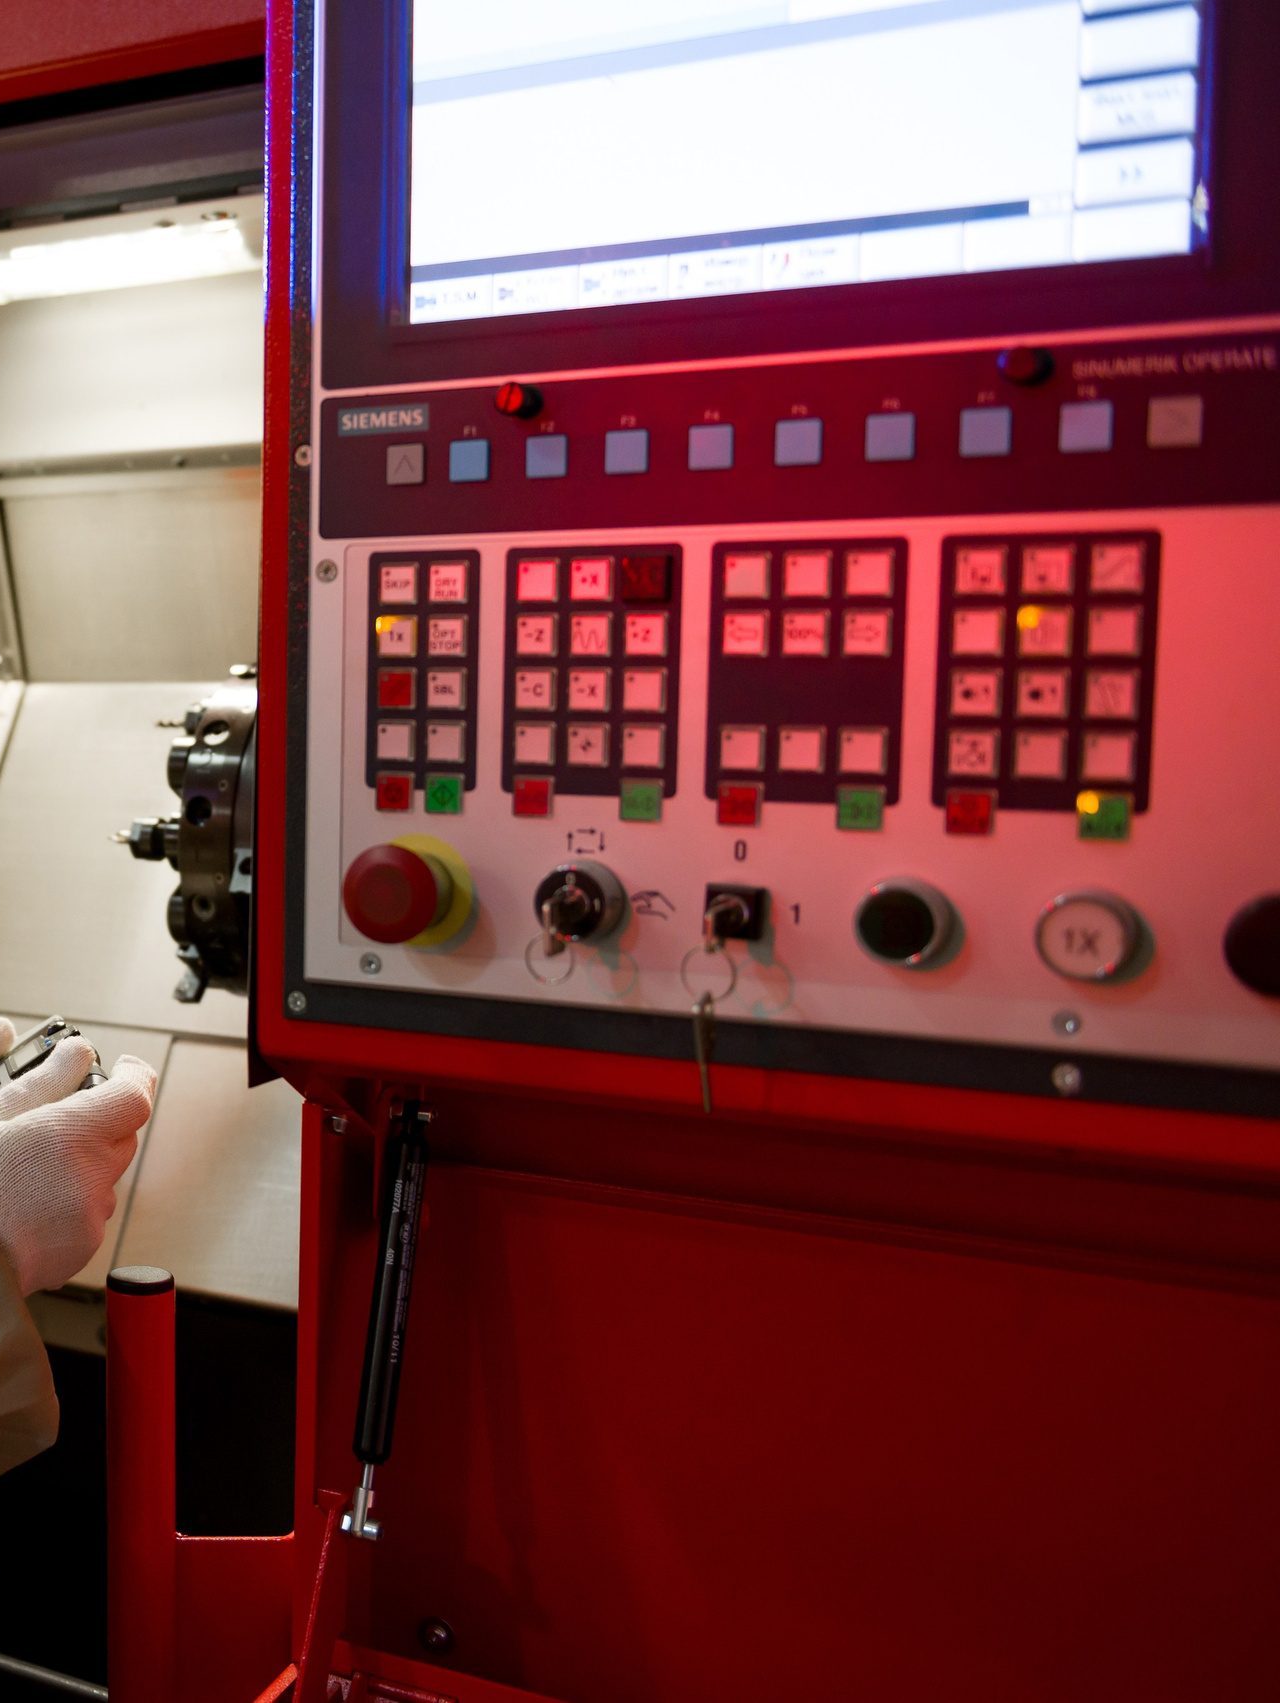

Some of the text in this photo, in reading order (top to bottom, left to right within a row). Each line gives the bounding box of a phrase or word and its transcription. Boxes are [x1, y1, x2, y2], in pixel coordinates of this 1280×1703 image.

[1072, 345, 1276, 380] SINUMERIK OPERATE
[341, 409, 424, 431] SIEMENS
[620, 415, 637, 427] F3
[463, 426, 477, 437] F1
[540, 421, 555, 432] F2
[384, 580, 411, 590] SKIP
[434, 578, 457, 587] DRY
[434, 589, 458, 598] RUN
[432, 629, 456, 639] OPT
[429, 641, 460, 650] STOP
[433, 685, 455, 695] SBL
[734, 839, 747, 862] 0
[790, 903, 801, 925] 1
[1062, 925, 1100, 957] 1X
[391, 1178, 403, 1214] 102077A
[385, 1247, 395, 1266] 40N
[390, 1334, 400, 1364] 10/11
